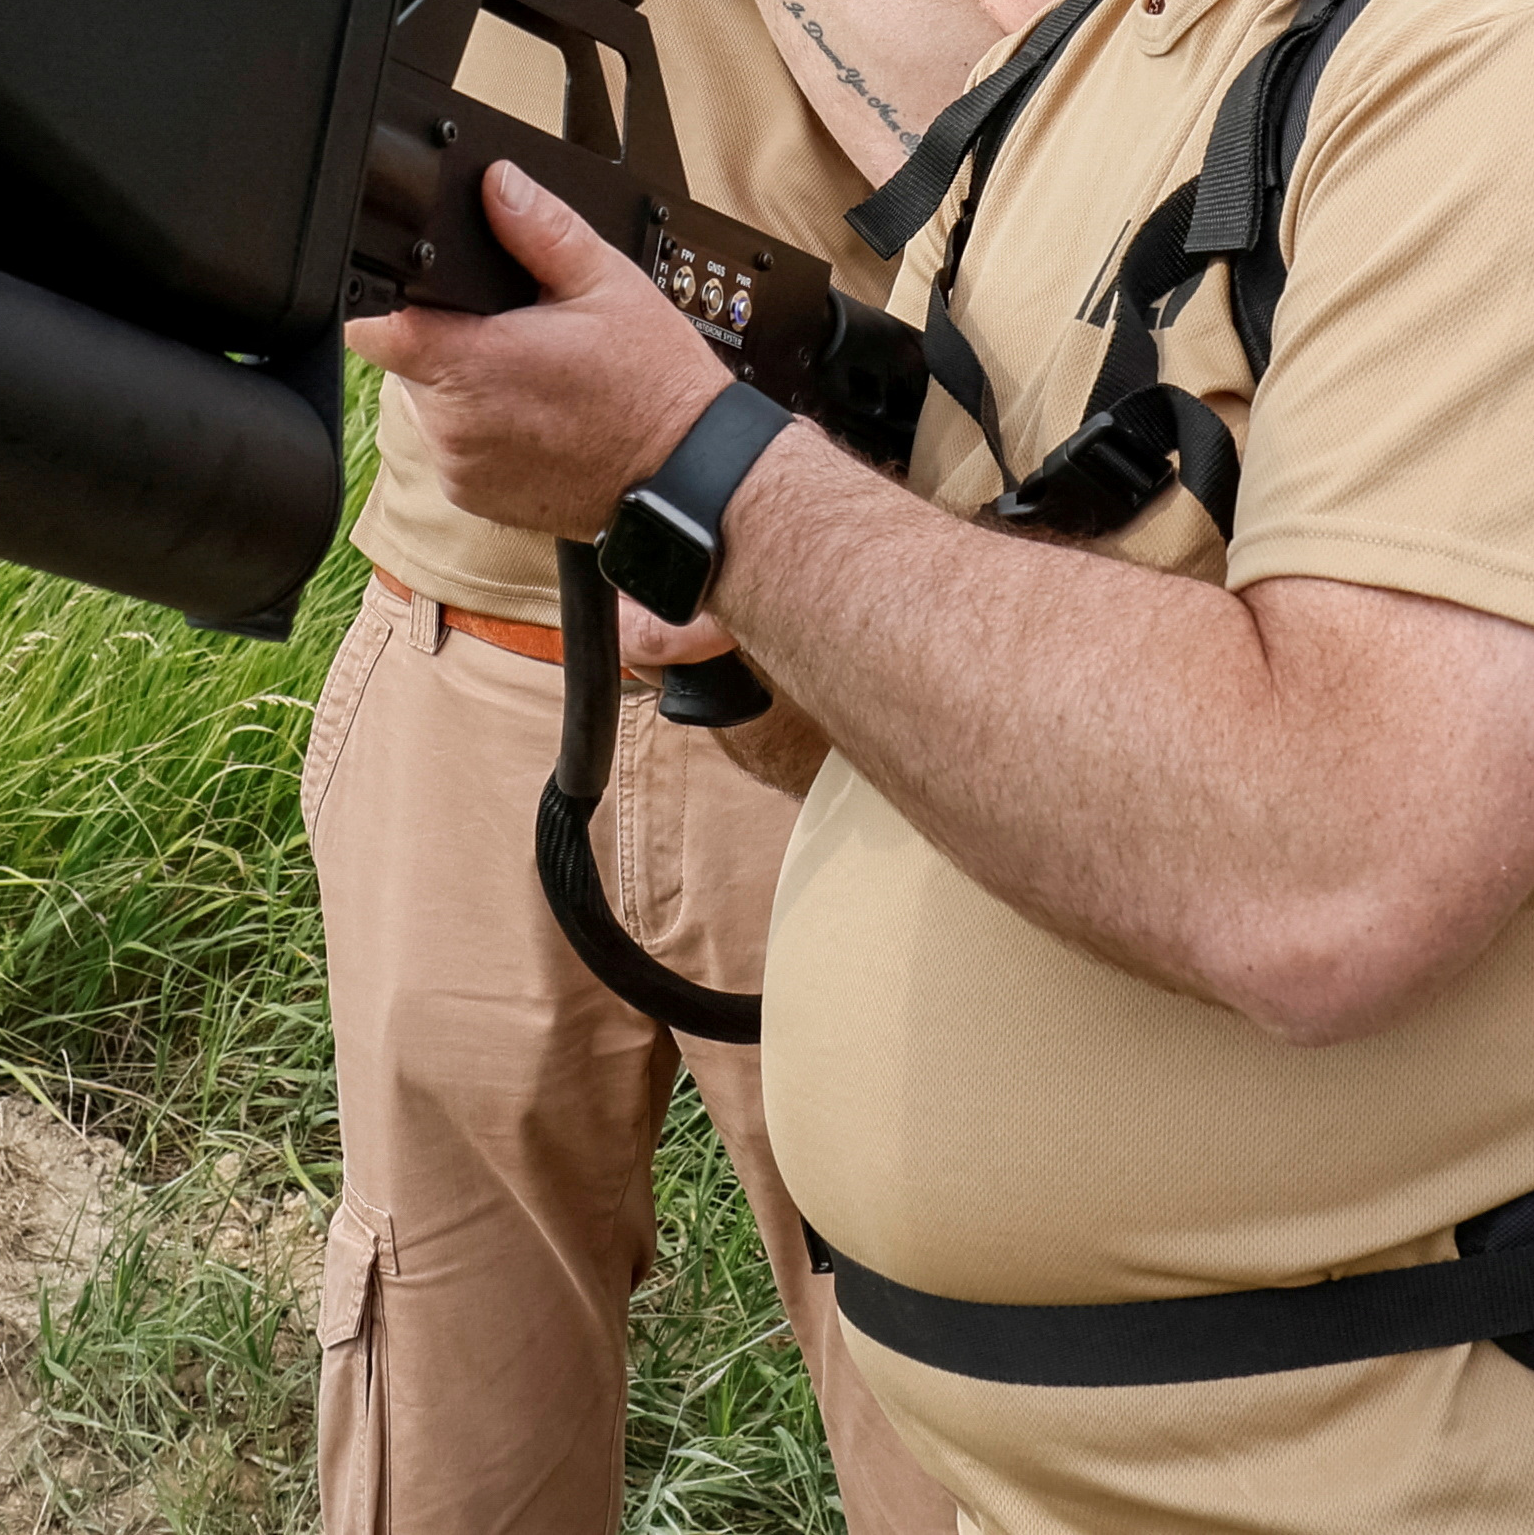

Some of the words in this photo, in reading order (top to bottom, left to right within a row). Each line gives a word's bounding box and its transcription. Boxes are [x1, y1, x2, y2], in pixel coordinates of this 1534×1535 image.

[681, 249, 696, 263] FPV
[659, 262, 669, 275] F1
[707, 260, 726, 277] GNSS
[657, 276, 667, 289] F2
[735, 273, 752, 288] PWR
[696, 320, 723, 338] ANTIDRONE
[723, 331, 743, 346] SYSTEM
